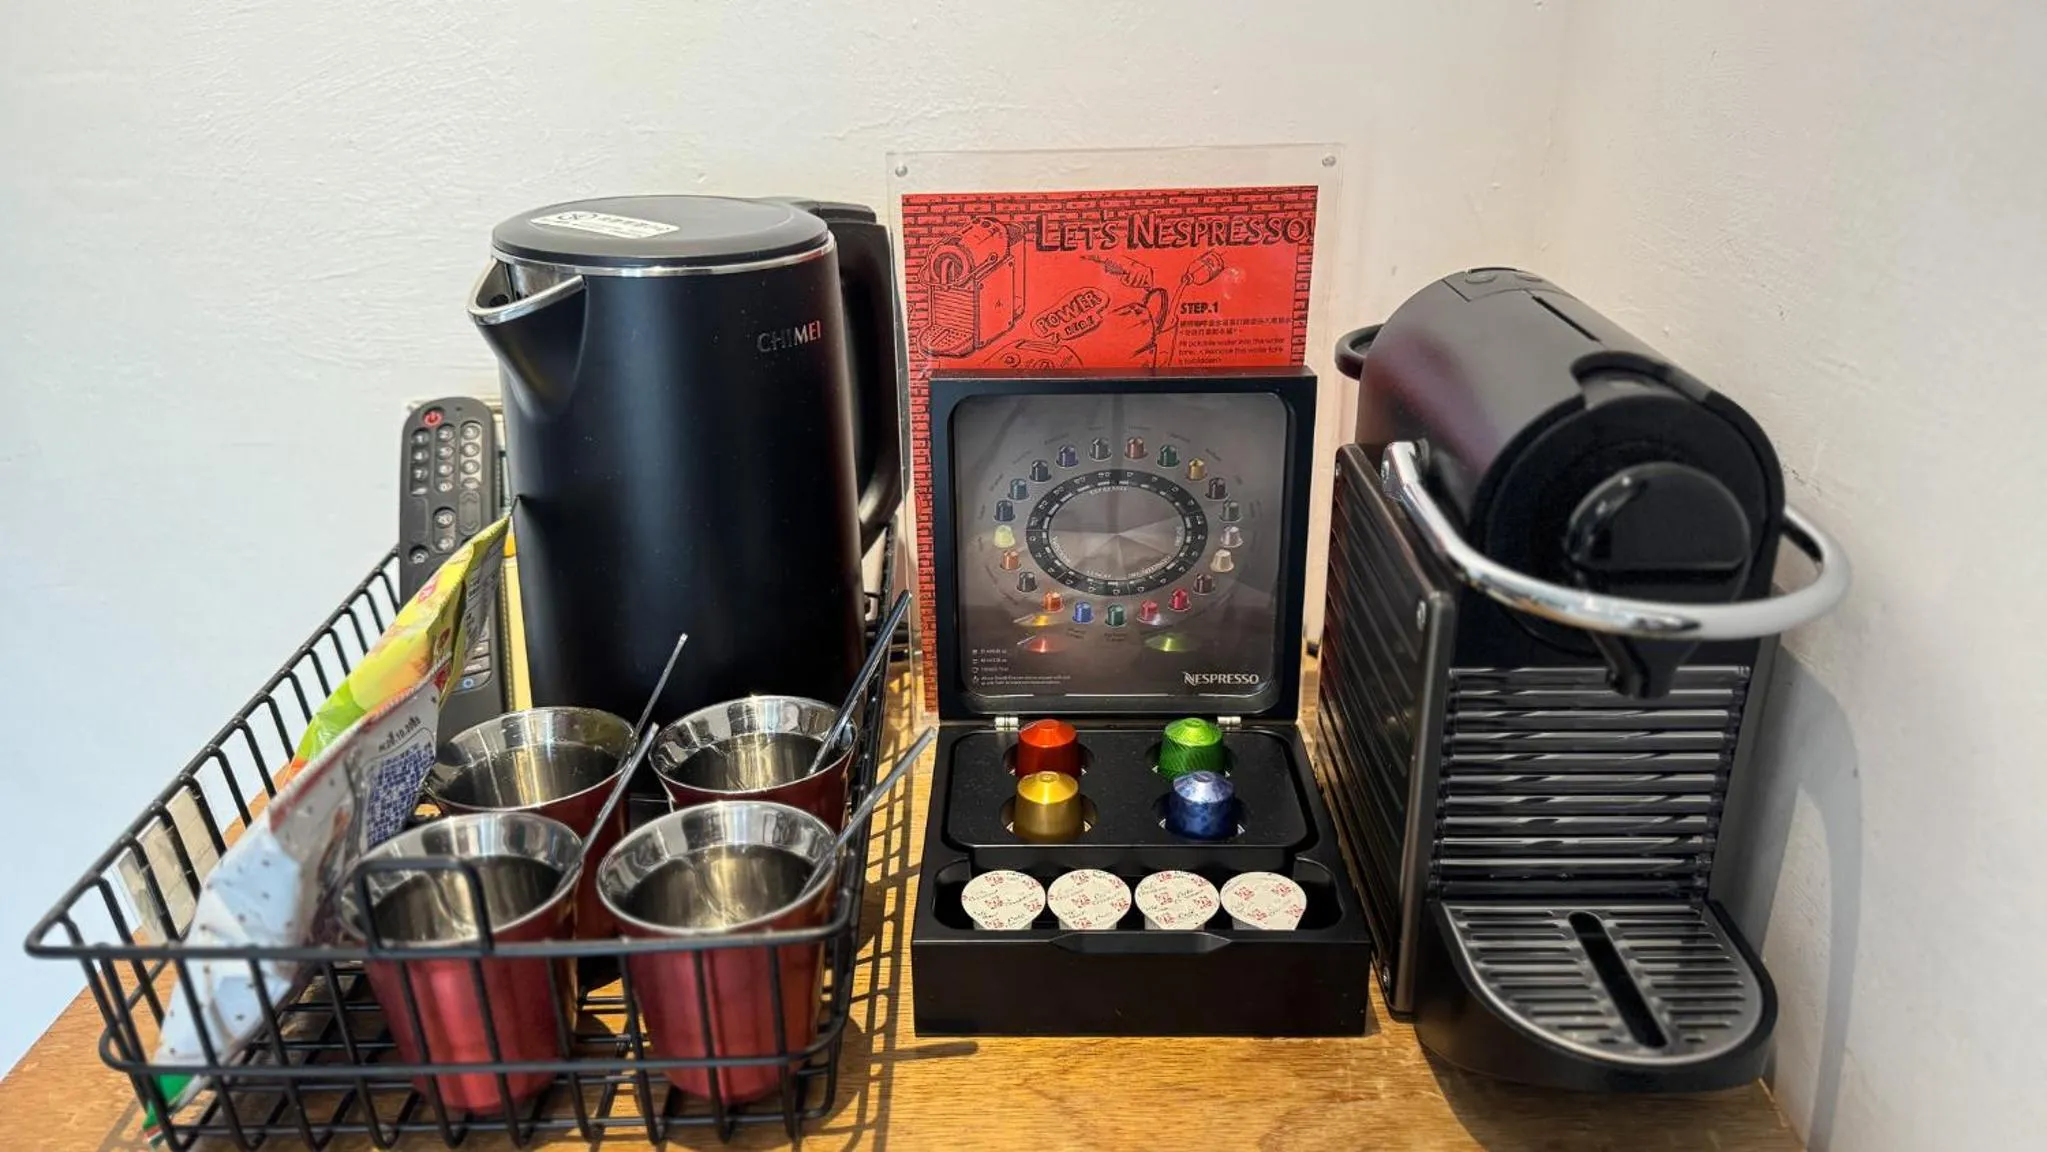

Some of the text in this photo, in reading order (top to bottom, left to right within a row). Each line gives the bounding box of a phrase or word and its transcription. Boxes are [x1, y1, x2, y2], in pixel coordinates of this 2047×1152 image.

[1036, 290, 1102, 333] POWER
[1180, 302, 1218, 314] STEP.1
[757, 320, 821, 352] CHIMEI
[1182, 671, 1260, 686] NESPRESSO
